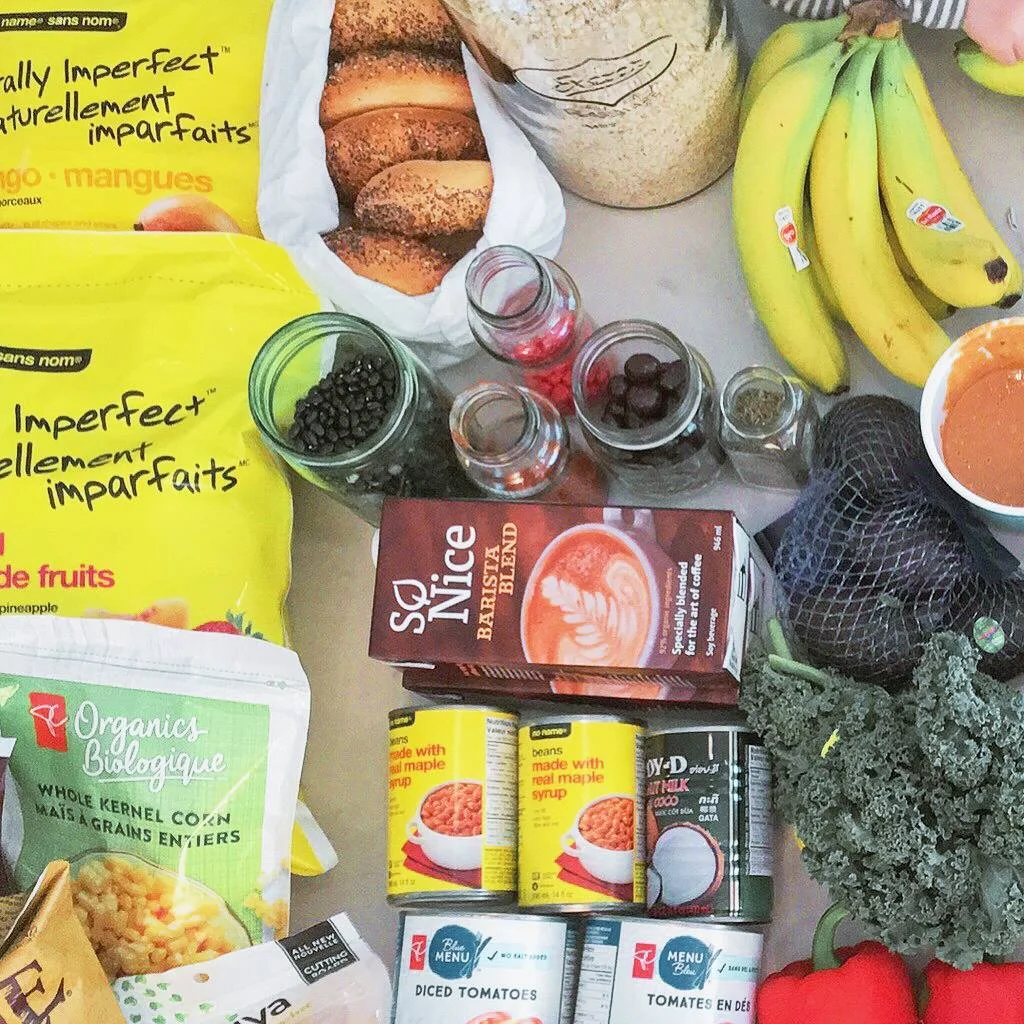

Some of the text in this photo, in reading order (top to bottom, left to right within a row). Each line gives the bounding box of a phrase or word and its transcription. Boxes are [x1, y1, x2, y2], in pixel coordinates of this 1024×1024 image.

[47, 16, 79, 26] sans
[64, 46, 219, 87] Imperfect
[88, 112, 251, 147] imparfaits
[64, 168, 213, 194] mangues
[15, 390, 205, 440] Imperfect
[47, 455, 238, 511] imparfaits
[428, 524, 477, 624] Nice
[499, 522, 519, 596] BLEND
[38, 565, 115, 588] fruits
[476, 545, 501, 641] BARISTA
[685, 554, 702, 656] for the art of coffee
[672, 562, 688, 655] Specially blended
[706, 608, 719, 656] Soy beverage
[74, 700, 208, 752] Organics
[416, 744, 446, 757] with
[532, 746, 563, 757] beans
[532, 757, 604, 771] made with
[83, 740, 226, 793] Biologique
[404, 759, 446, 773] maple
[532, 772, 604, 786] real maple
[37, 783, 232, 827] WHOLE KERNEL CORN
[532, 788, 567, 801] syrup
[34, 802, 75, 822] MAÏS
[92, 819, 153, 843] GRAINS
[158, 830, 242, 849] ENTIERS
[304, 951, 348, 974] CUTTING
[435, 951, 470, 963] MENU
[667, 951, 704, 963] MENU
[415, 984, 537, 1001] DICED TOMATOES
[647, 993, 712, 1010] TOMATES
[717, 999, 732, 1012] EN
